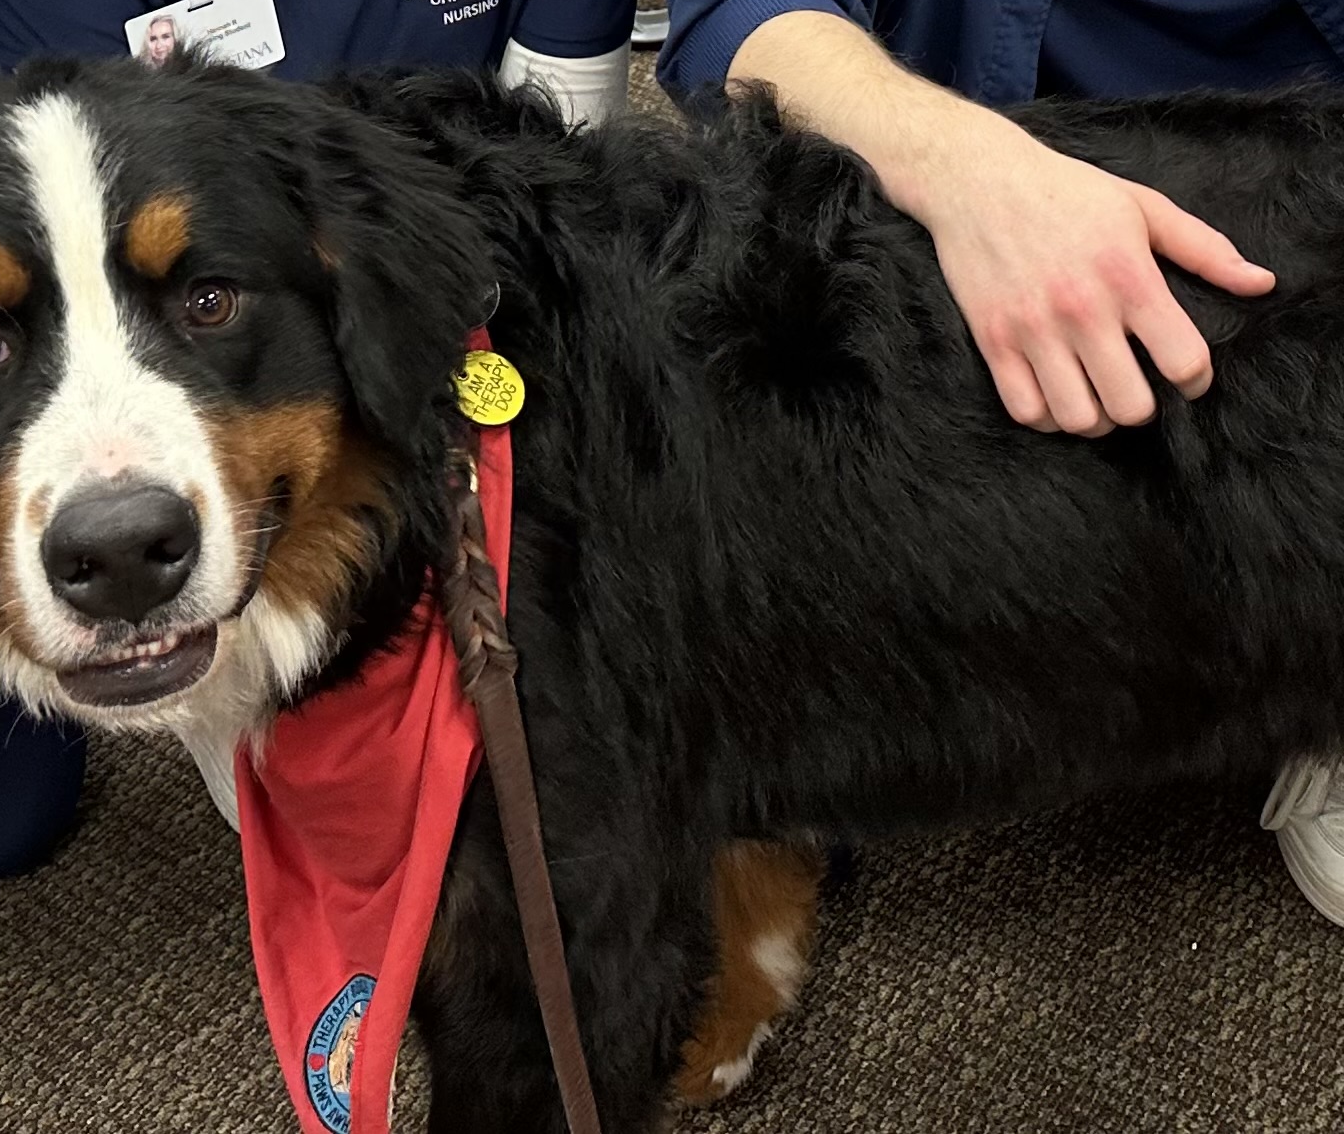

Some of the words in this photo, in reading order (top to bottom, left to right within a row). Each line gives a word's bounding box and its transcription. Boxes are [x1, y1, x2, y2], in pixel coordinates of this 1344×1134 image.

[468, 373, 487, 396] AM
[479, 361, 492, 373] A
[473, 358, 509, 417] THERAPY
[495, 382, 517, 411] DOG
[313, 988, 350, 1049] THERAPY
[312, 1073, 333, 1112] PAWS
